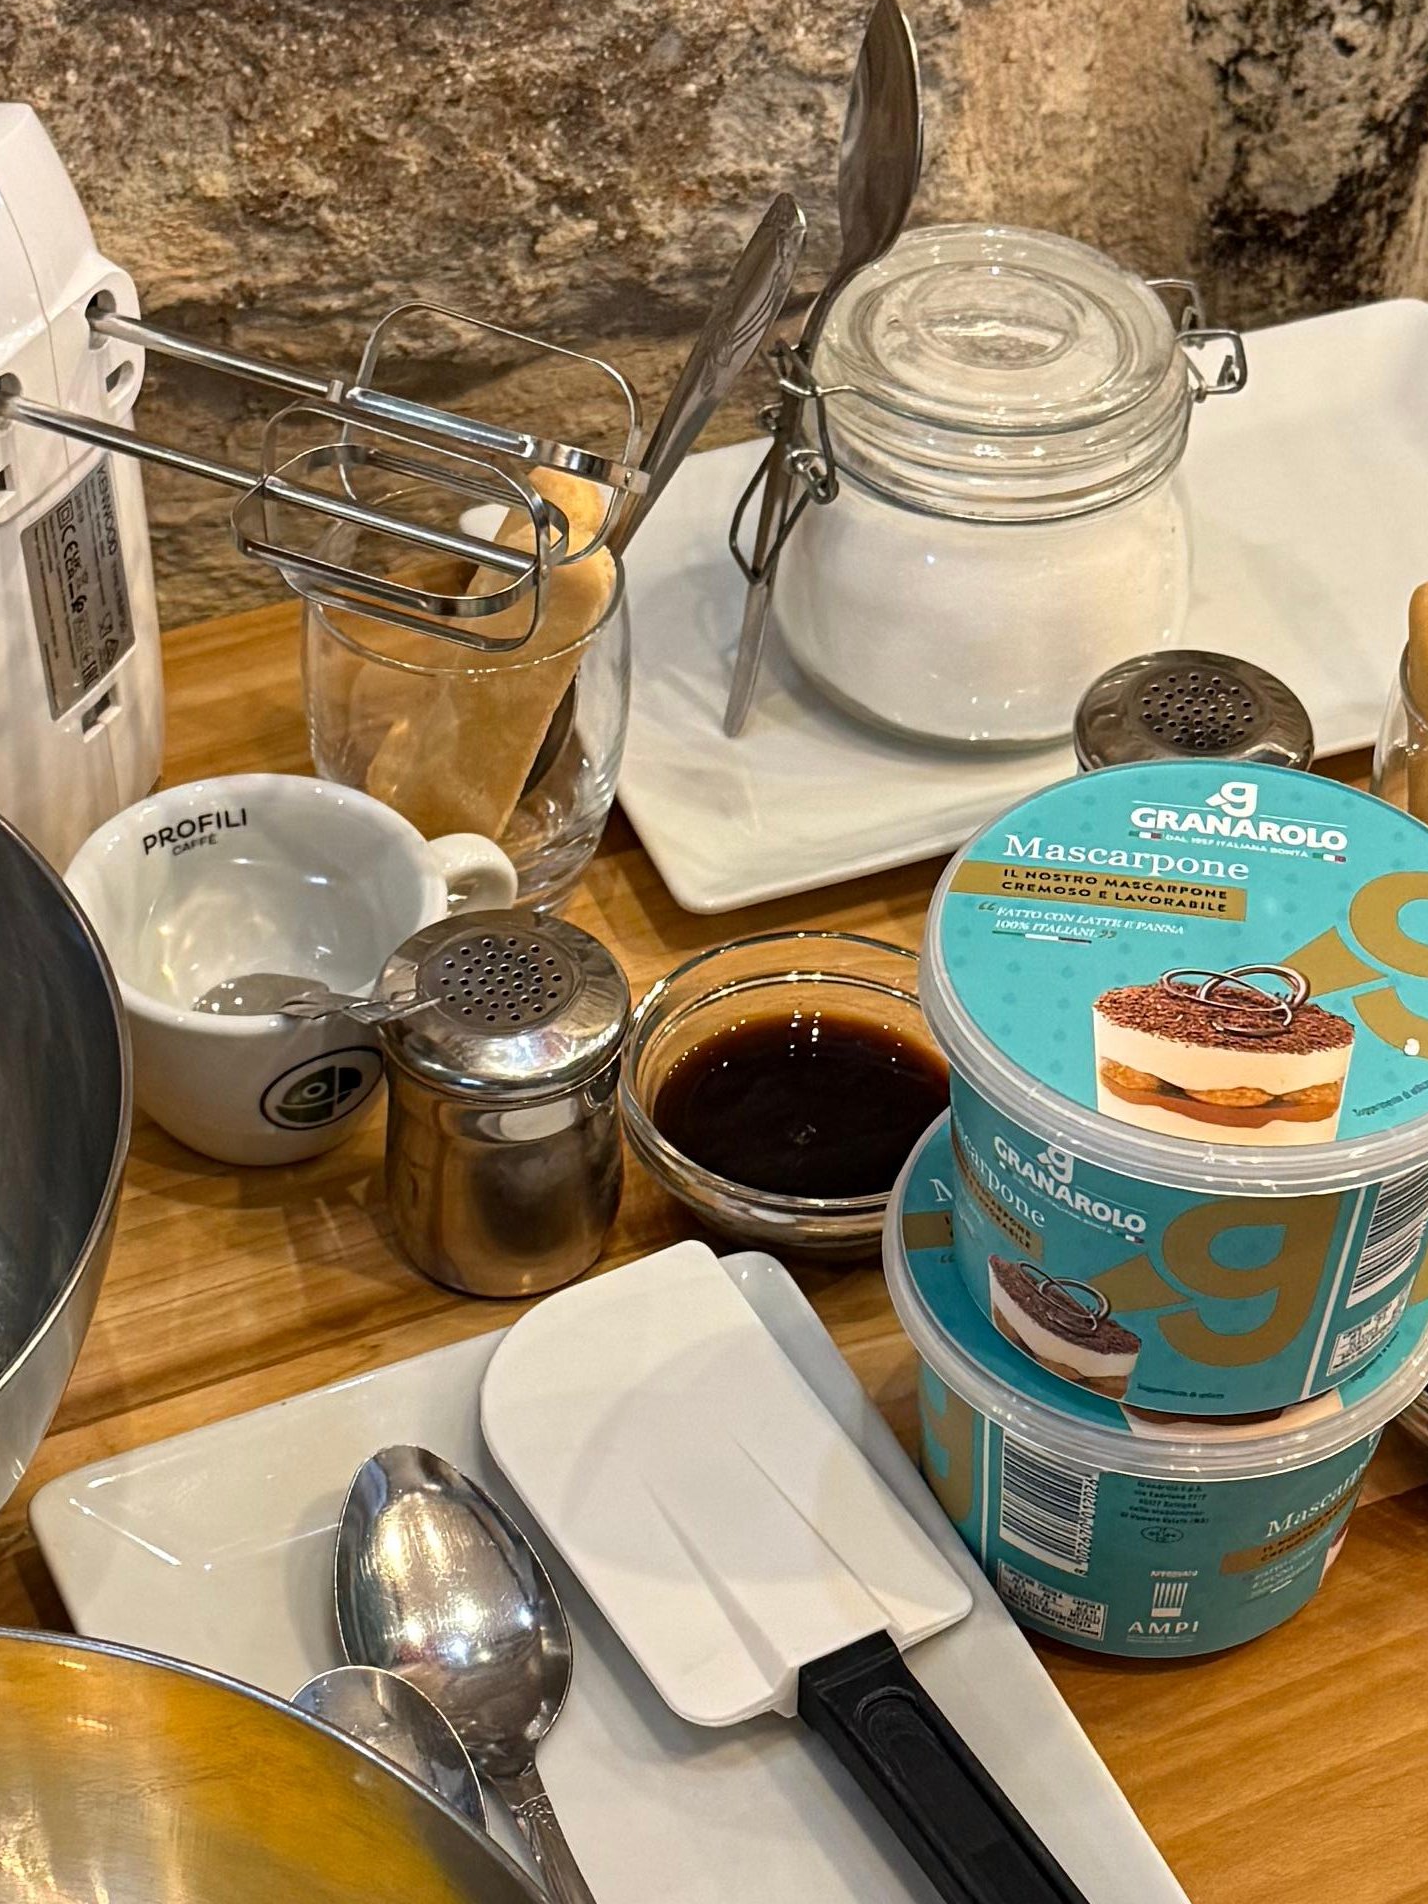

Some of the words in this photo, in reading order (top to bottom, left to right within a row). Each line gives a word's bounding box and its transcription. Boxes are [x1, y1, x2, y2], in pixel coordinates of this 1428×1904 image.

[96, 463, 118, 556] KENWOOD
[142, 807, 247, 856] PROFILI
[1130, 807, 1348, 851] GRANAROLO
[1002, 834, 1249, 880] Mascarpone
[1002, 881, 1091, 897] CREMOSO
[1099, 891, 1108, 900] E
[1115, 892, 1227, 913] LAVORABILE
[1003, 868, 1019, 879] IL
[1025, 871, 1098, 885] NOSTRO
[1104, 880, 1227, 900] MASCARPONE
[995, 919, 1030, 931] 100%
[1044, 911, 1075, 924] CON
[1076, 915, 1122, 929] LATTE
[1135, 921, 1184, 935] PANNA
[993, 1135, 1148, 1234] GRANAROLO
[1127, 1620, 1199, 1634] AMPI
